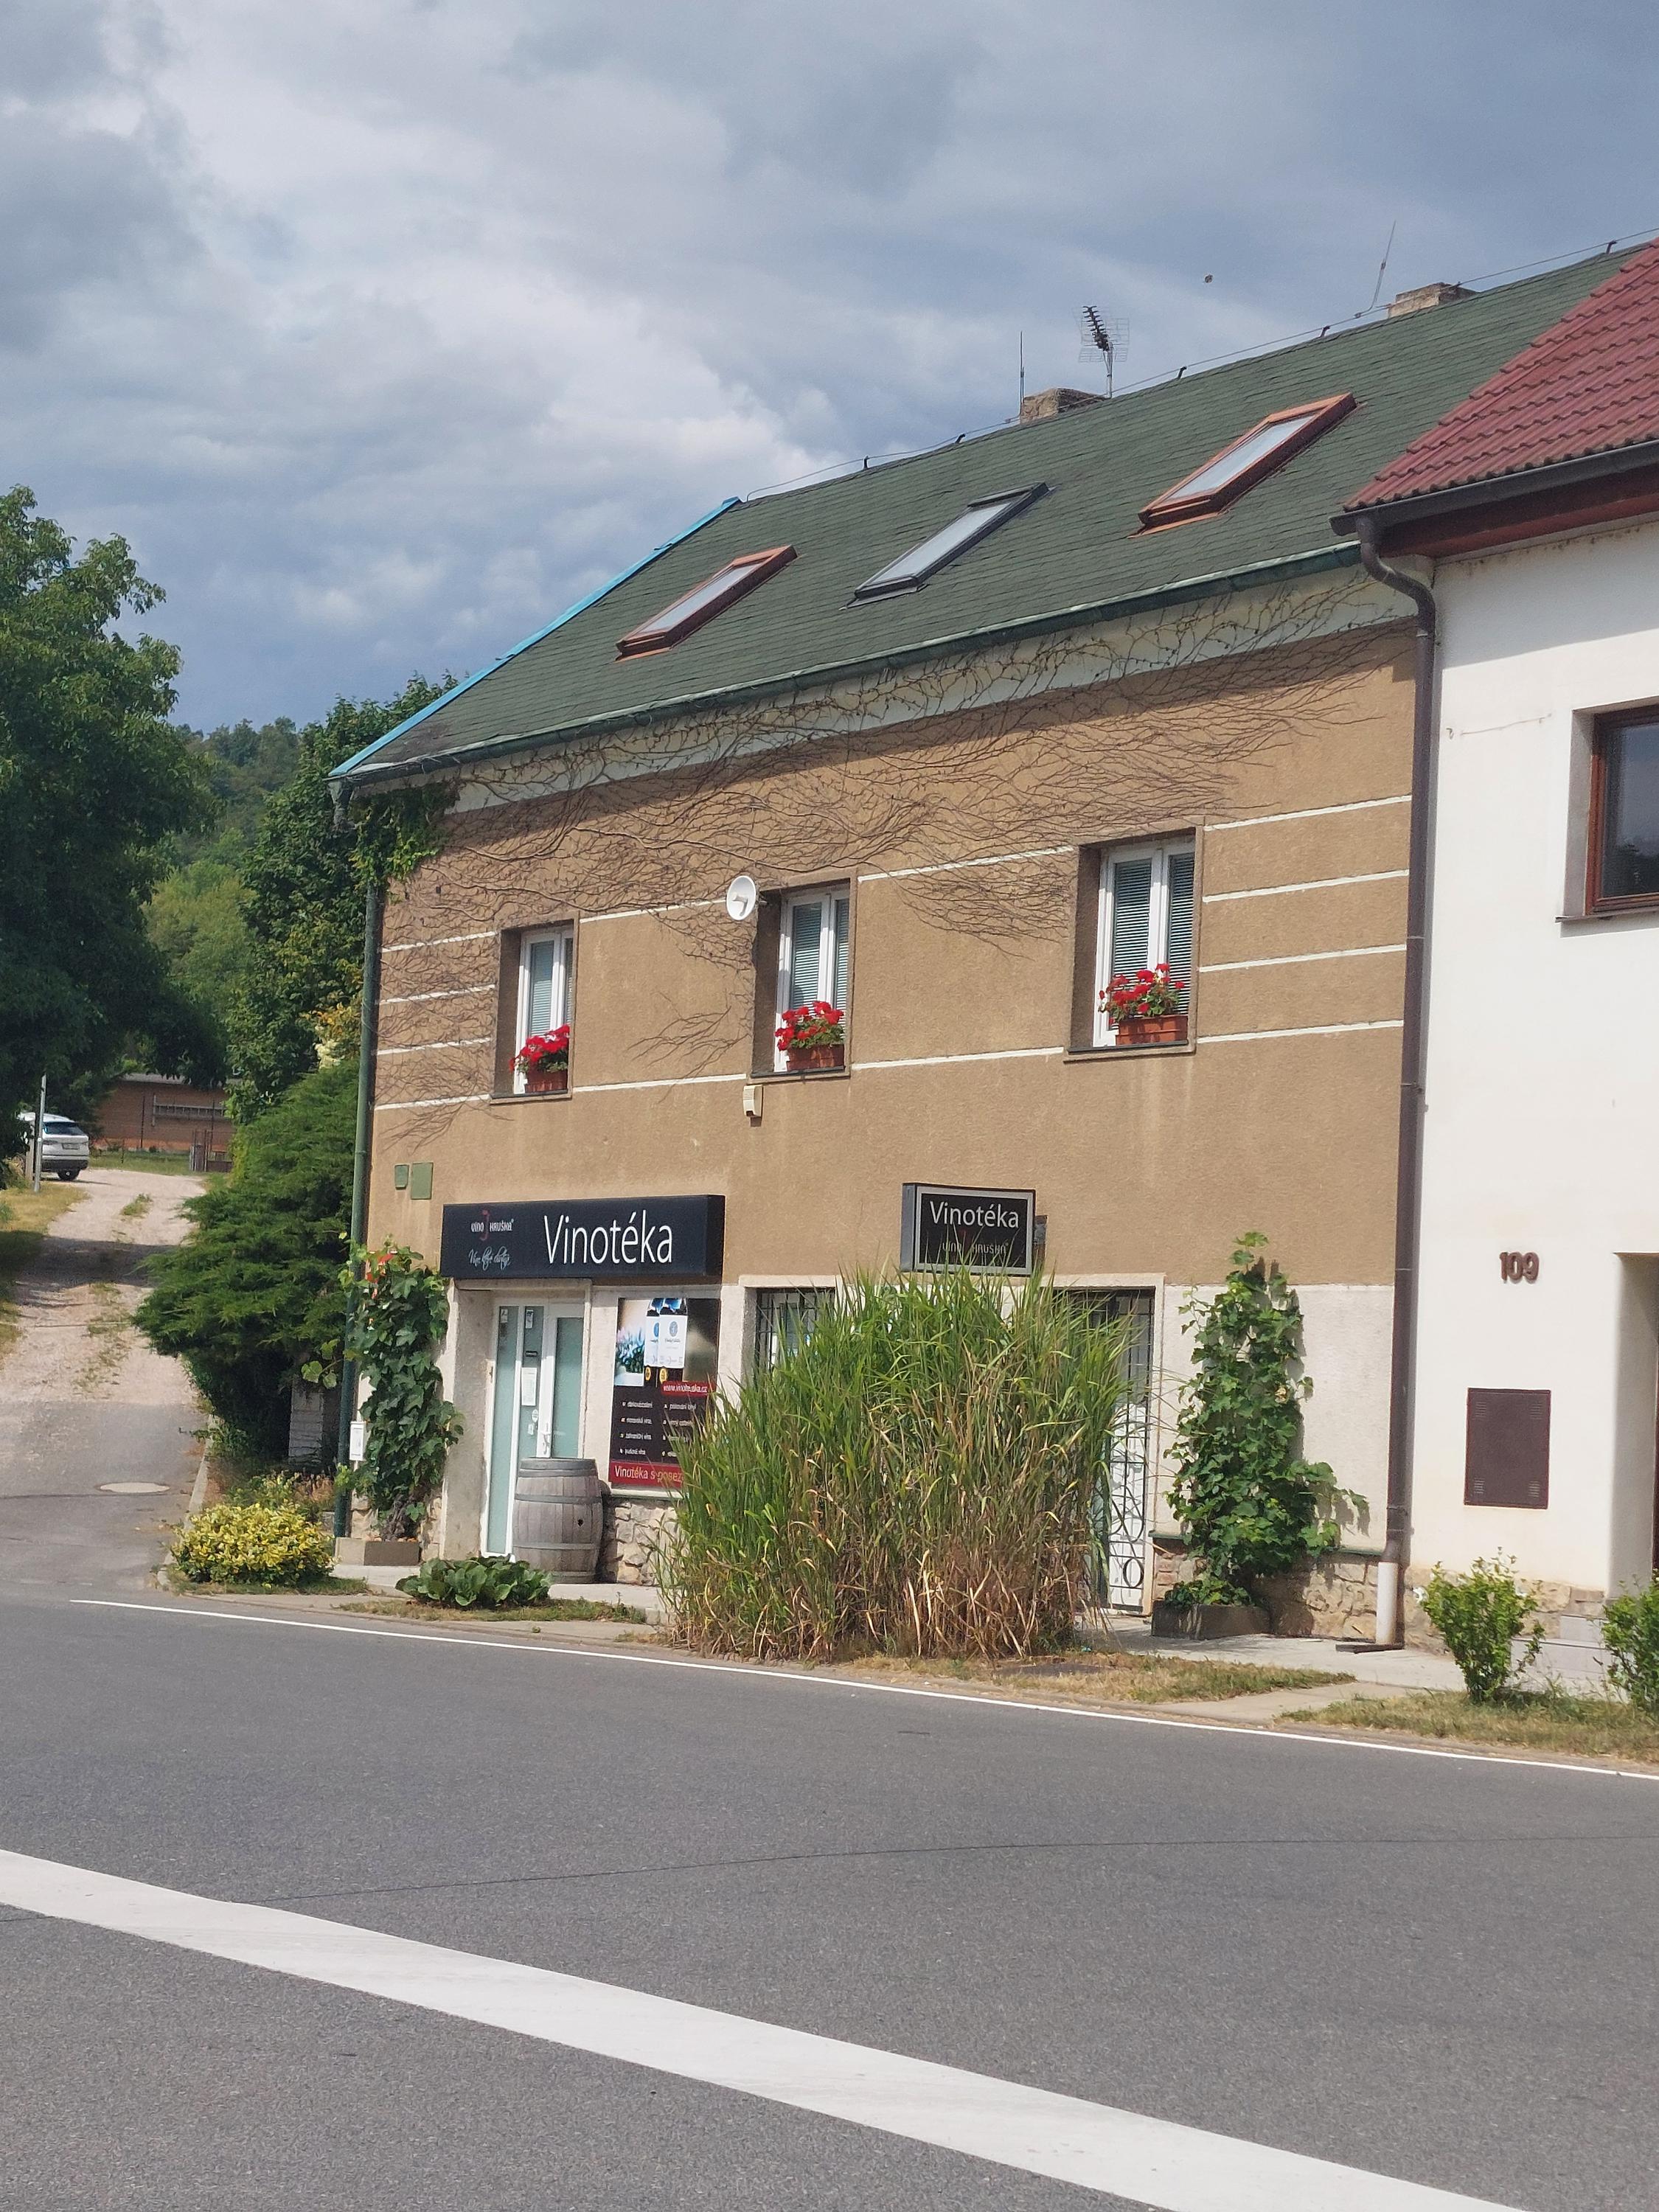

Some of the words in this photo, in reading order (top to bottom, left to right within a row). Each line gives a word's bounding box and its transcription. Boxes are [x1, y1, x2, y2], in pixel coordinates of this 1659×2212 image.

[930, 1200, 1019, 1228] Vinotéka
[544, 1209, 672, 1265] Vinotéka
[1499, 1251, 1540, 1283] 109
[614, 1465, 648, 1479] Vinotéka
